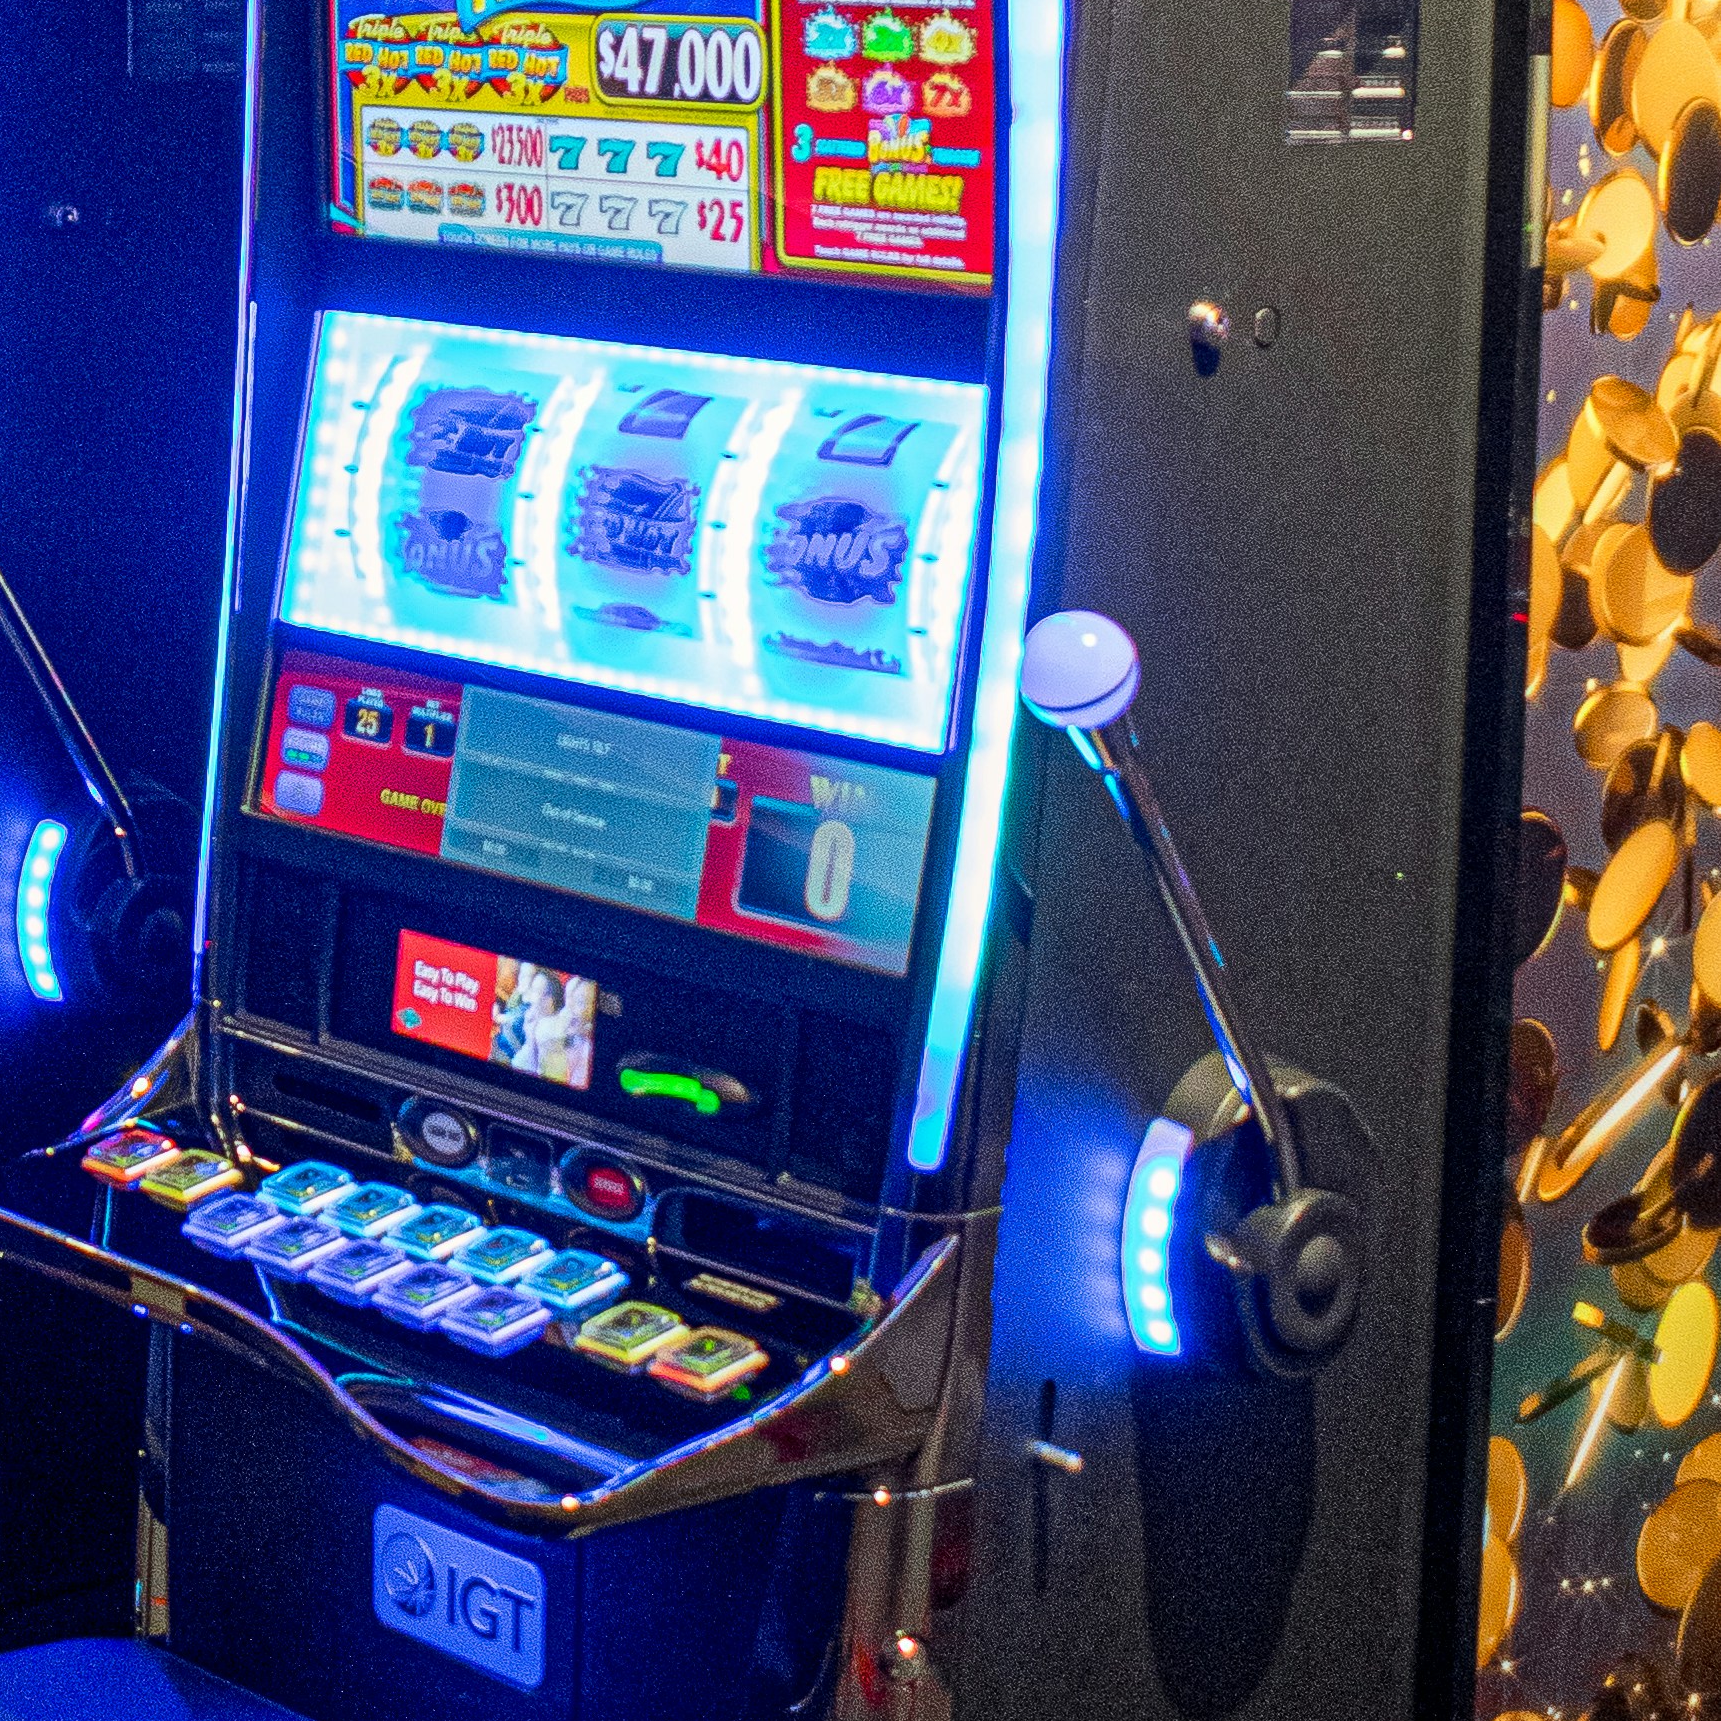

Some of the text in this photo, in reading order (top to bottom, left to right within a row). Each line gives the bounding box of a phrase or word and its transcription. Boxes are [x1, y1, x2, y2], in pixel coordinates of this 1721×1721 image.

[378, 47, 409, 69] HOT
[449, 50, 482, 73] HOT
[524, 53, 560, 76] HOT
[598, 25, 762, 102] $47,000
[550, 134, 746, 182] 7 7 7 $40
[813, 166, 871, 204] FREE
[495, 182, 544, 226] $300
[551, 190, 746, 244] 7 7 7 $25
[356, 708, 380, 737] 25
[425, 724, 434, 748] 1
[380, 788, 420, 811] GAME
[805, 820, 856, 921] 0
[414, 979, 478, 1013] Easy To Win
[415, 960, 480, 997] Easy To Play
[447, 1562, 535, 1654] IGT
